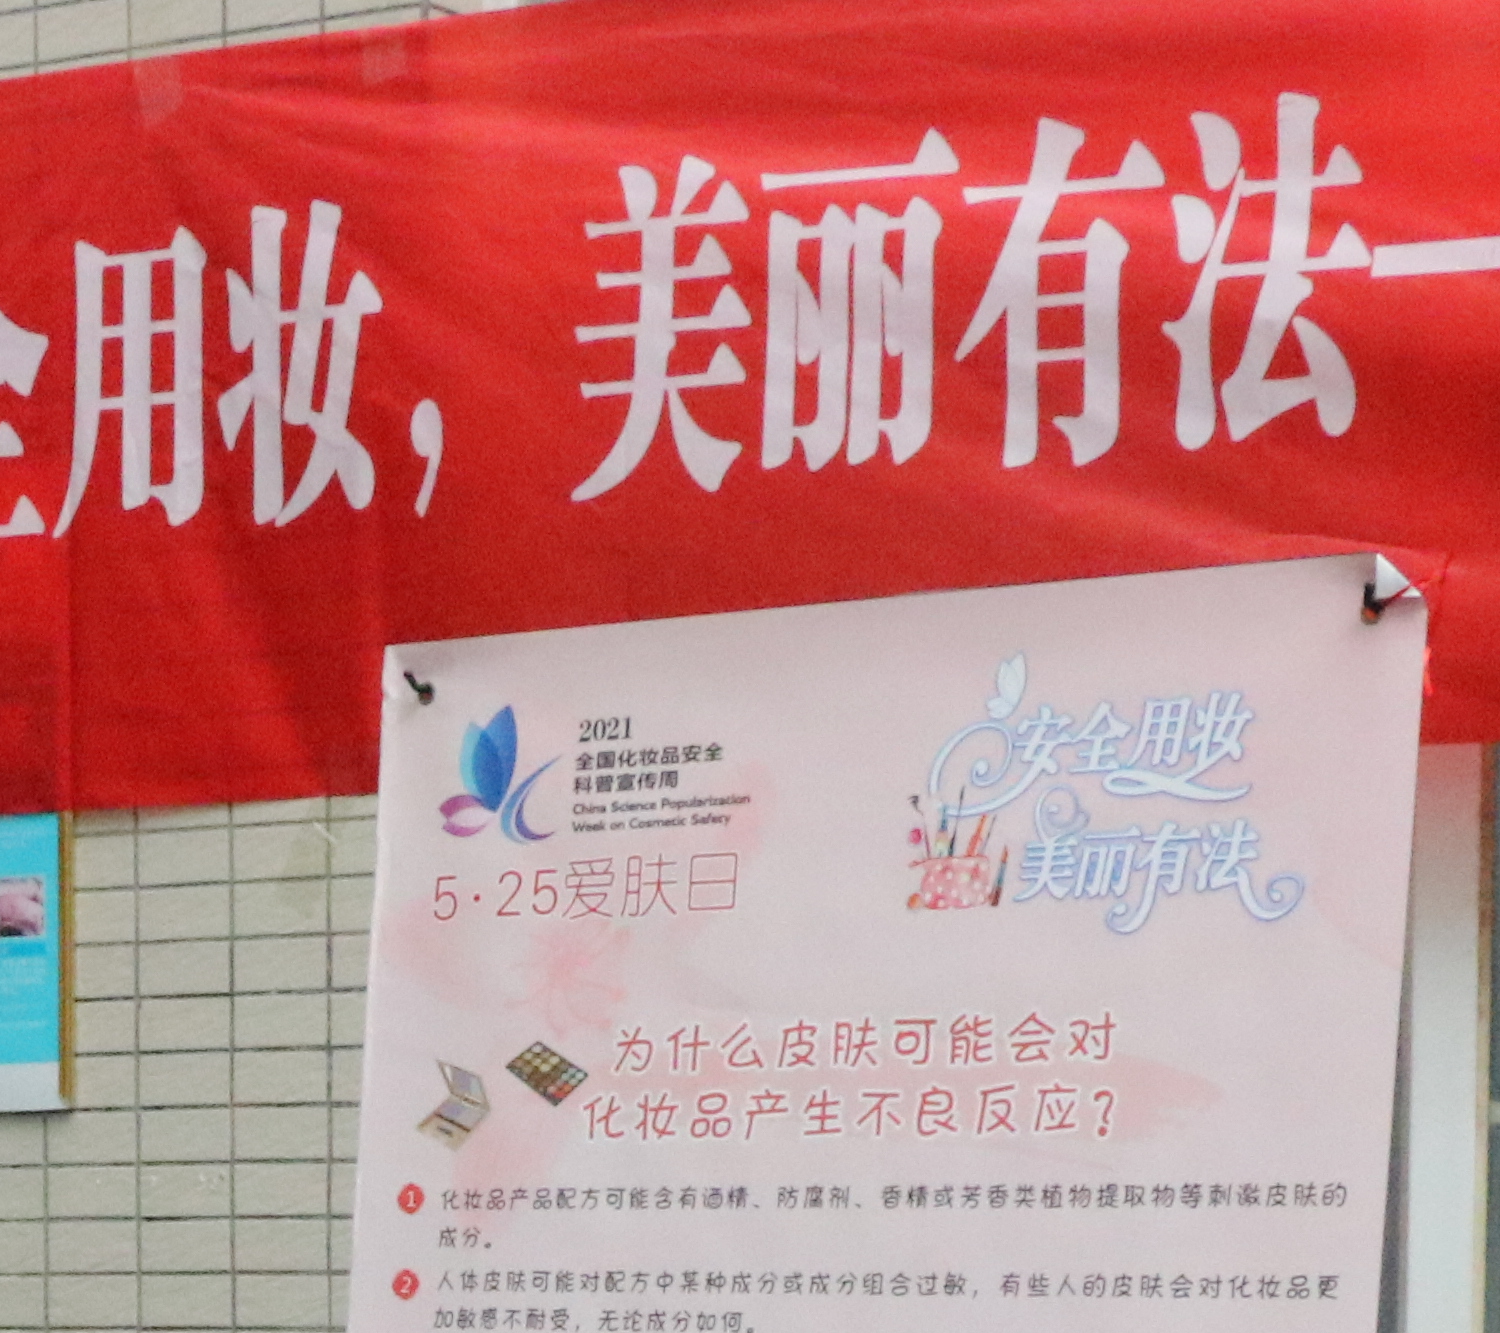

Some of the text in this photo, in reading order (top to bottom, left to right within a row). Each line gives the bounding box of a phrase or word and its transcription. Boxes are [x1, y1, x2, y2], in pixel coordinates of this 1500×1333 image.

[578, 716, 633, 742] 2021
[575, 742, 723, 771] 全国化妆品安全
[1012, 692, 1256, 801] 安全用妆
[573, 770, 678, 794] 科普宣传周
[572, 794, 750, 816] China Science Popularization
[572, 812, 732, 833] Week on Cosmetic Safety
[433, 851, 740, 922] 5·25爱肤日
[1012, 818, 1305, 935] 美丽有法
[612, 1010, 1118, 1075] 为什么皮肤可能会对
[583, 1083, 1116, 1142] 化妆品产生不良反应？
[437, 1228, 495, 1250] 成分。
